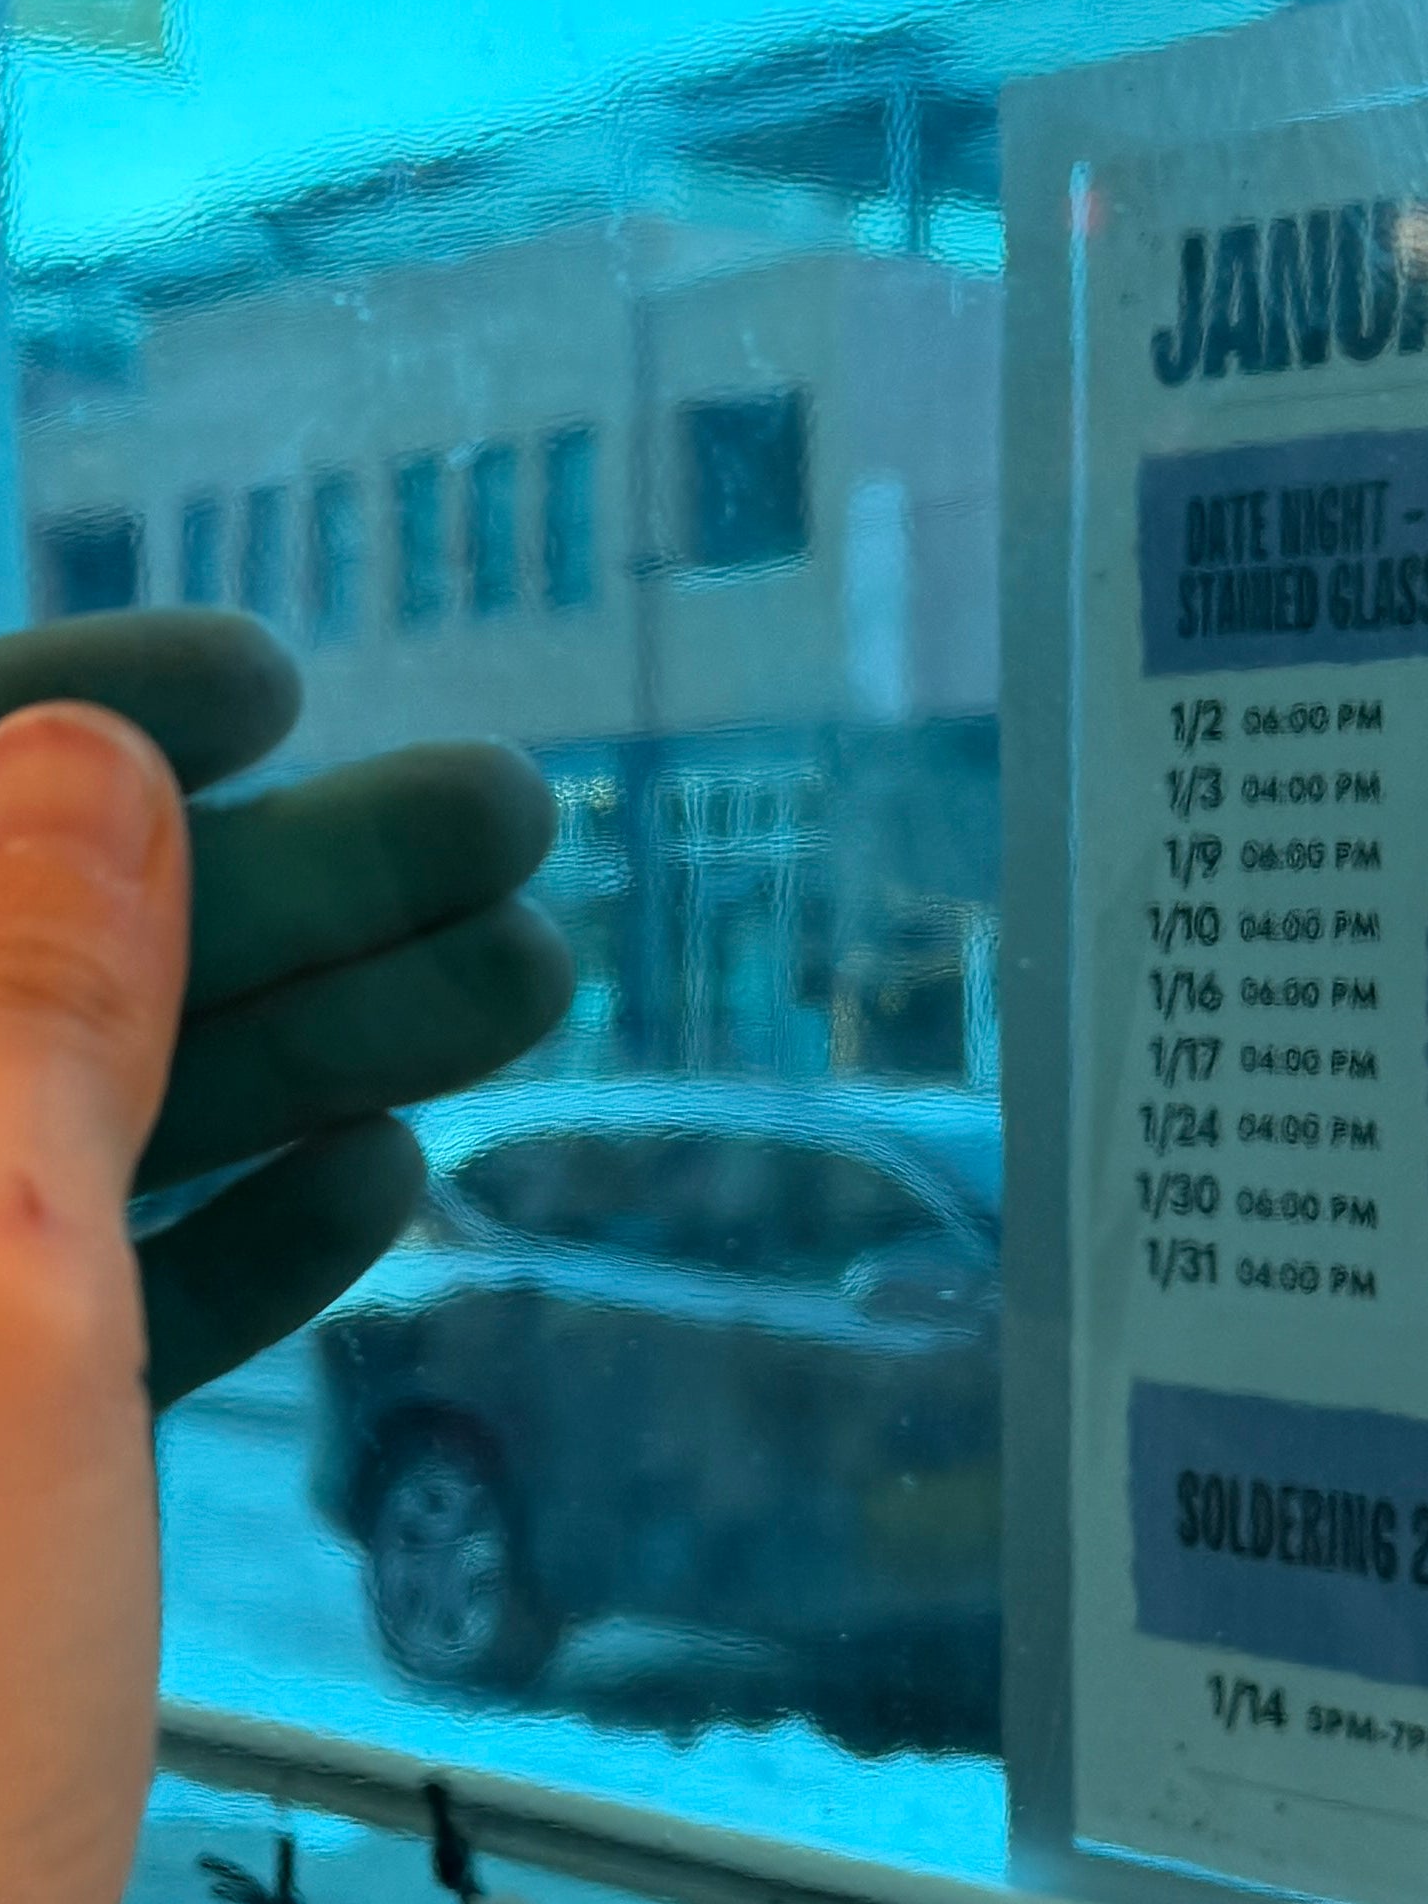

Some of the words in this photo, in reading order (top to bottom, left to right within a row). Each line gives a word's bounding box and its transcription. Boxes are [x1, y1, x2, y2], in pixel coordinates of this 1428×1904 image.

[1183, 490, 1268, 567] DATE
[1277, 479, 1390, 558] NIGHT
[1177, 561, 1319, 640] STAINED
[1170, 698, 1225, 756] 1/2
[1337, 701, 1383, 733] PM
[1166, 764, 1225, 822] 1/3
[1334, 771, 1382, 804] PM
[1334, 839, 1382, 871] PM
[1146, 903, 1221, 956] 1/10
[1333, 909, 1380, 942] PM
[1148, 967, 1223, 1022] 1/16
[1332, 977, 1379, 1010] PM
[1148, 1034, 1224, 1091] 1/17
[1330, 1048, 1379, 1081] PM
[1137, 1101, 1219, 1158] 1/24
[1329, 1115, 1379, 1150] PM
[1135, 1168, 1220, 1218] 1/30
[1329, 1194, 1379, 1231] PM
[1144, 1235, 1218, 1292] 1/31
[1329, 1264, 1378, 1300] PM
[1175, 1467, 1398, 1584] SOLDERING
[1206, 1670, 1288, 1734] 1/14
